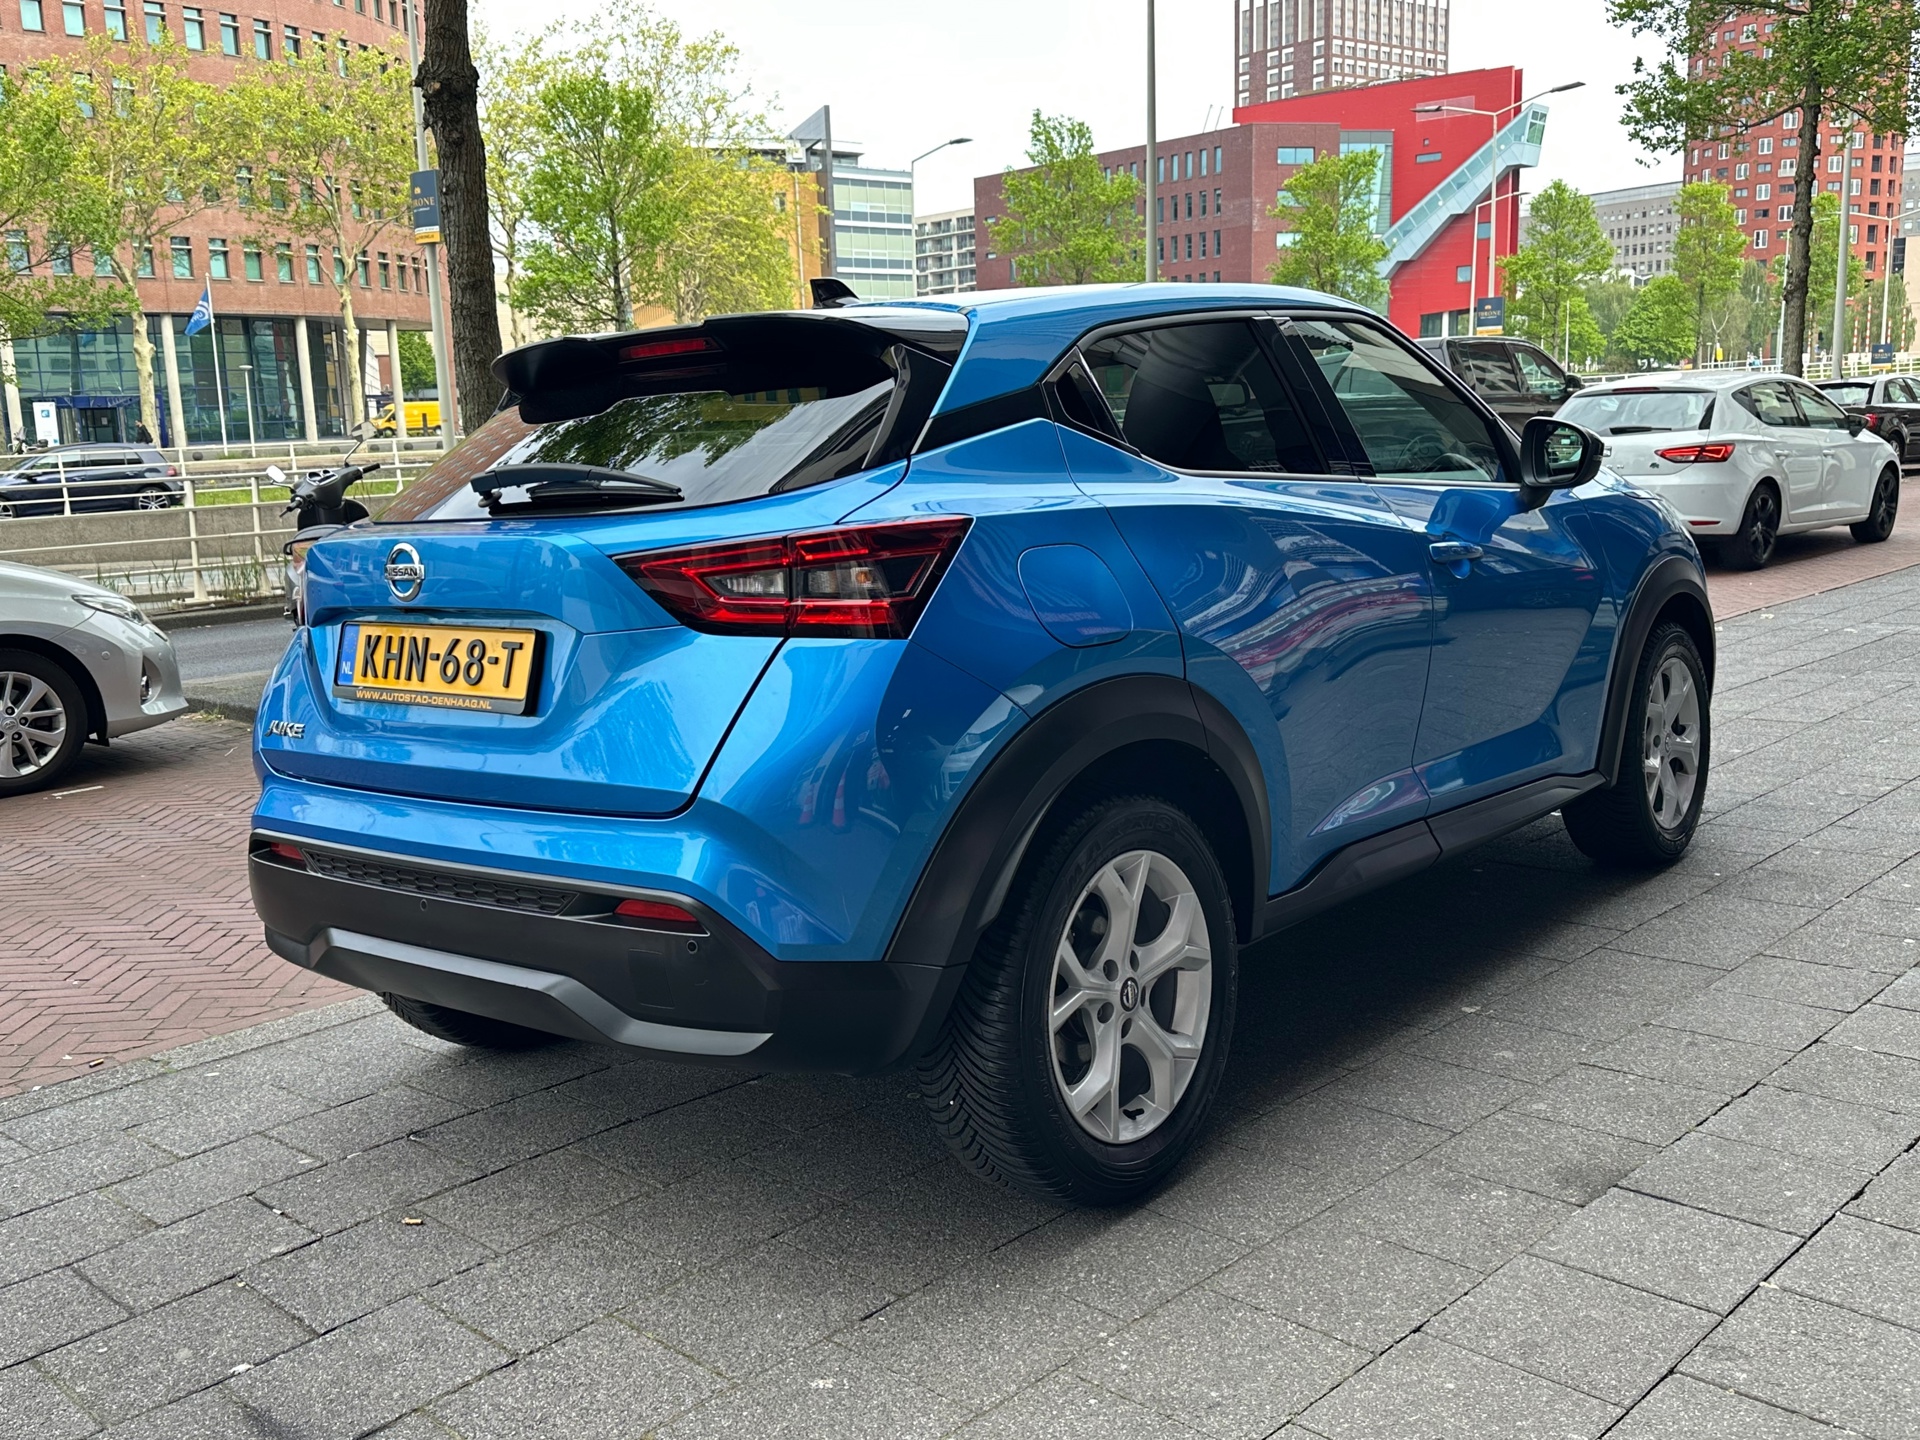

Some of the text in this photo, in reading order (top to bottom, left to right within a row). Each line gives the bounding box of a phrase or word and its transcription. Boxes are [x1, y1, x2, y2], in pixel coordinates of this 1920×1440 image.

[385, 567, 418, 577] NISSAN
[341, 661, 353, 675] NL
[361, 634, 524, 688] KHN-68-T
[355, 689, 493, 710] WWW.AUTOSTAD-DENHAAG.NL
[265, 720, 306, 739] JUKE
